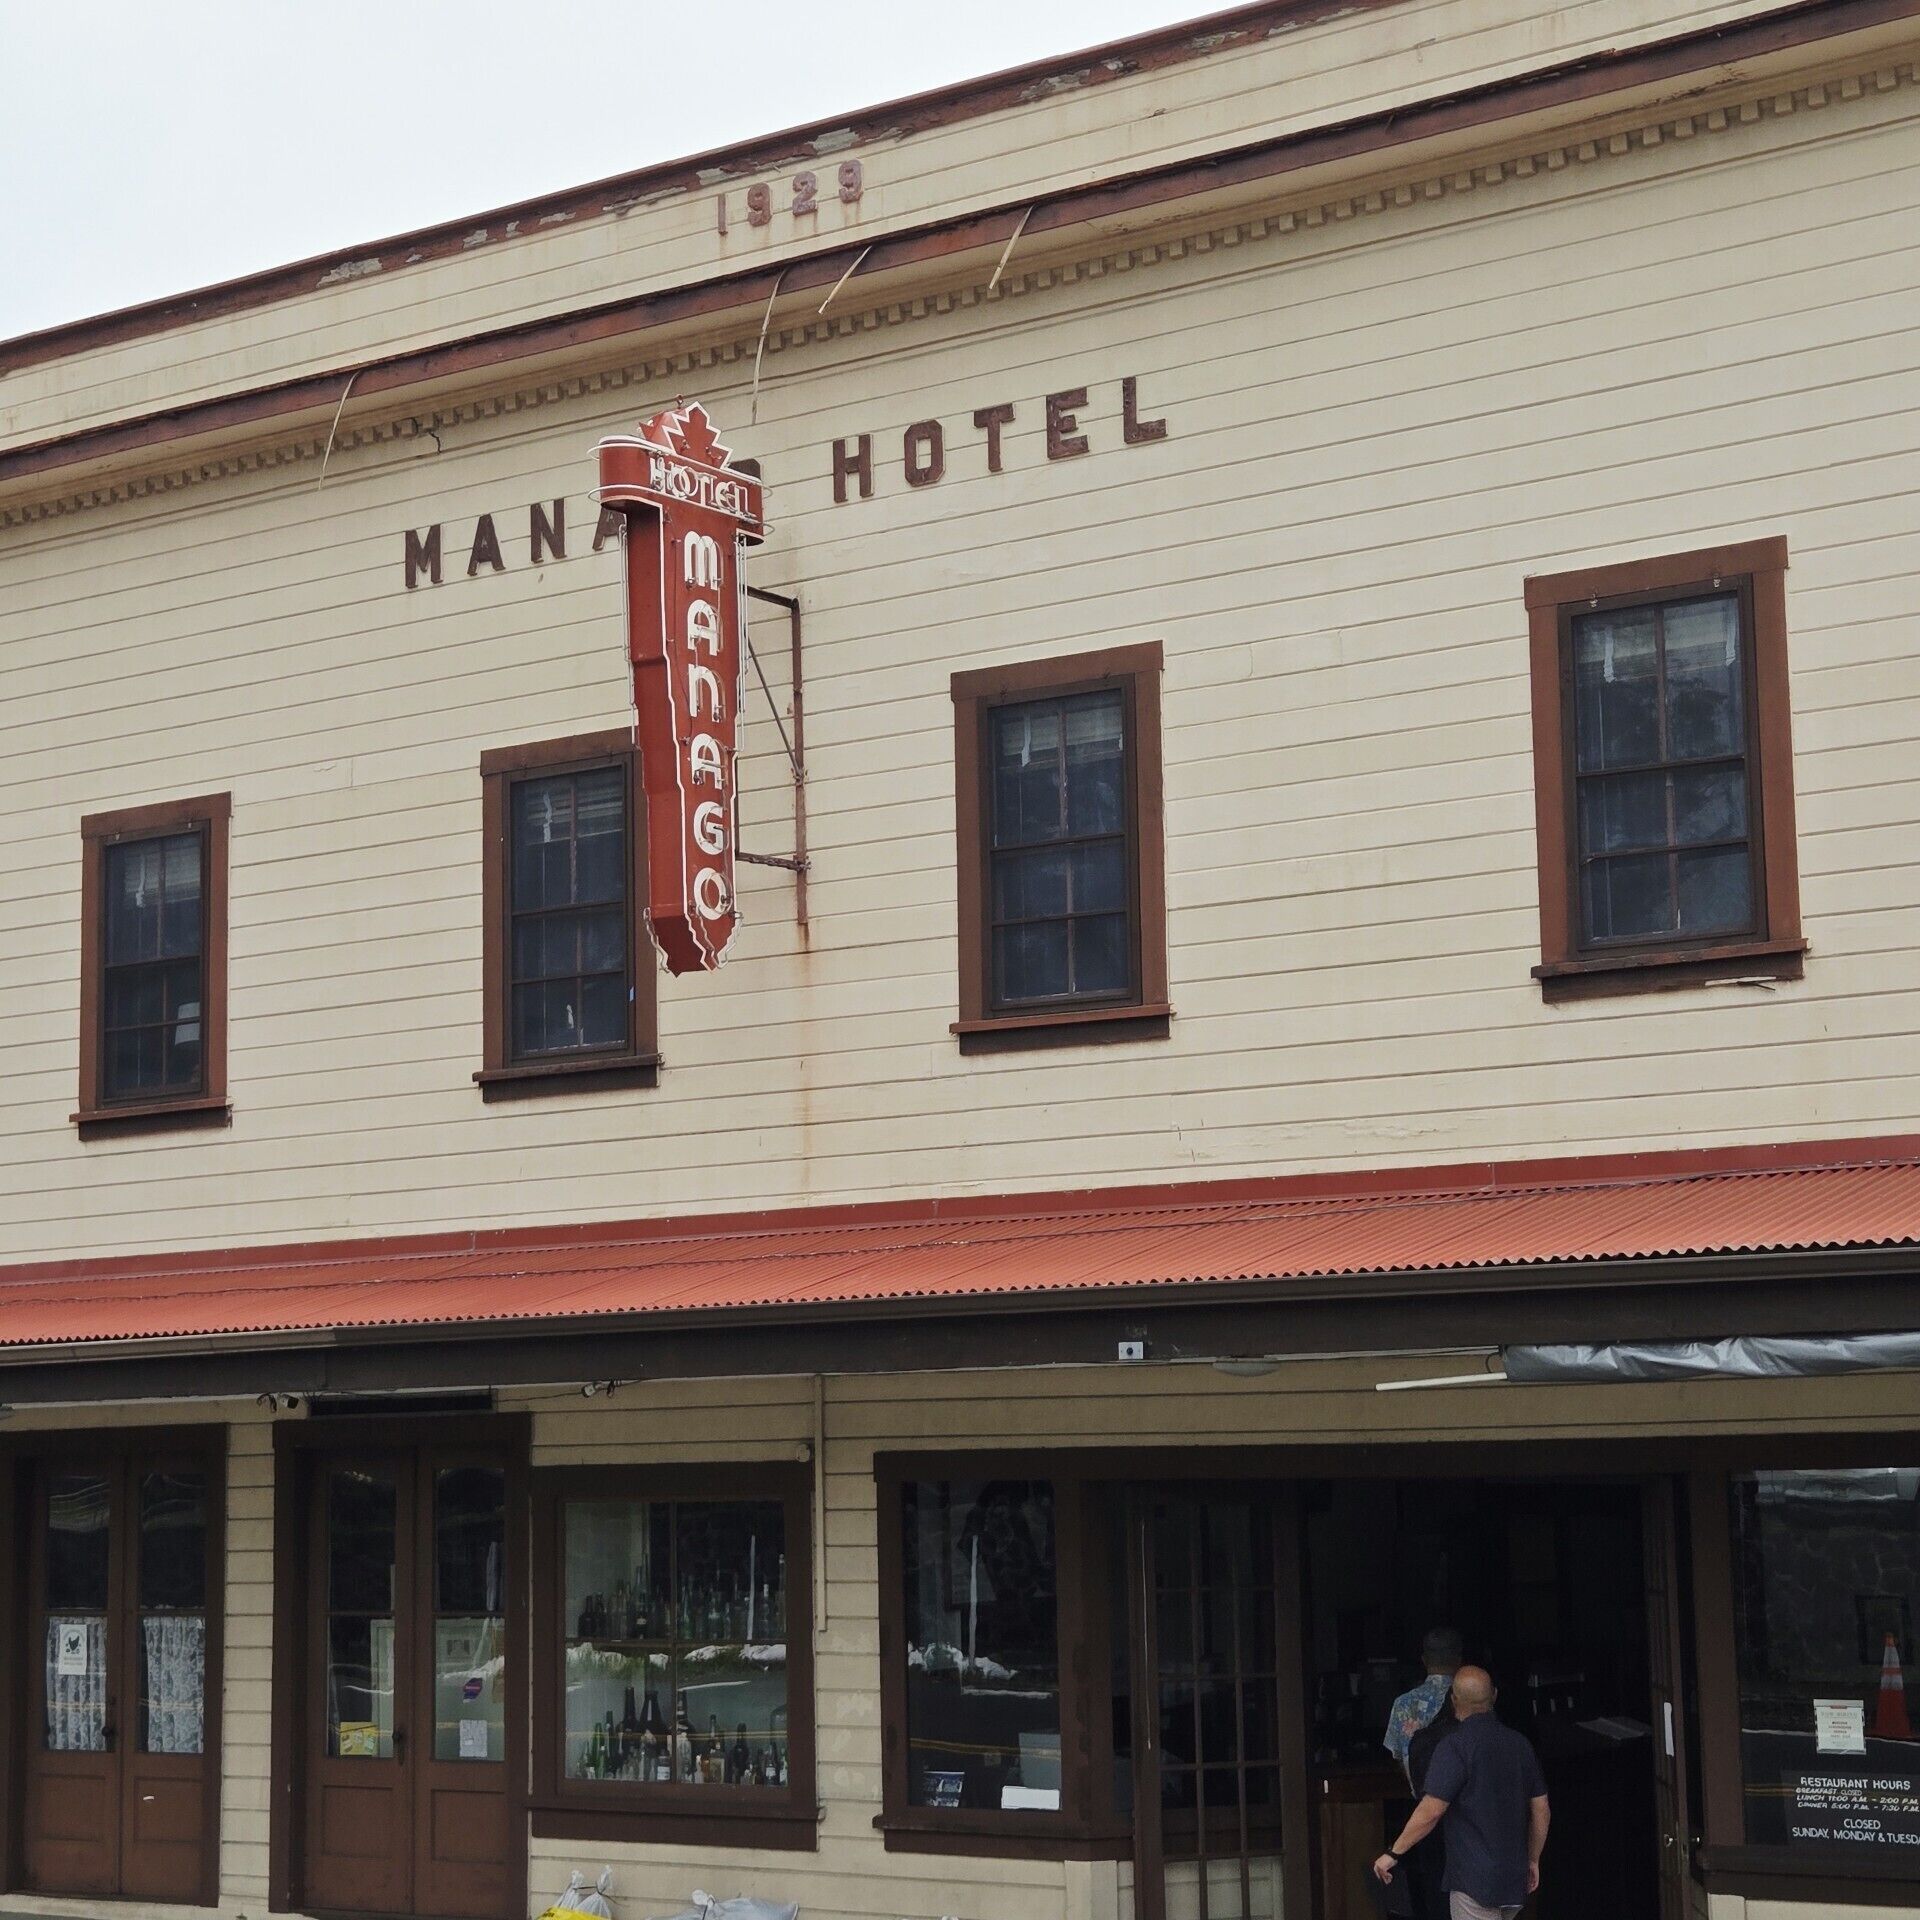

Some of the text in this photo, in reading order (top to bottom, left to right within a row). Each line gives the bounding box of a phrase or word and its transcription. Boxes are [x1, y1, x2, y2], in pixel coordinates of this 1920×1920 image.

[717, 159, 864, 235] 1929
[832, 376, 1168, 503] HOTEL
[650, 455, 760, 524] HOTEL
[684, 530, 733, 921] MANAGO
[1800, 1777, 1911, 1790] RESTAURANT HOURS
[1796, 1787, 1837, 1795] BREAKFAST
[1797, 1801, 1828, 1809] DINNER
[1881, 1804, 1900, 1812] 7:30
[1843, 1818, 1881, 1830] CLOSED
[1833, 1829, 1876, 1842] MONDAY
[1878, 1832, 1886, 1843] &
